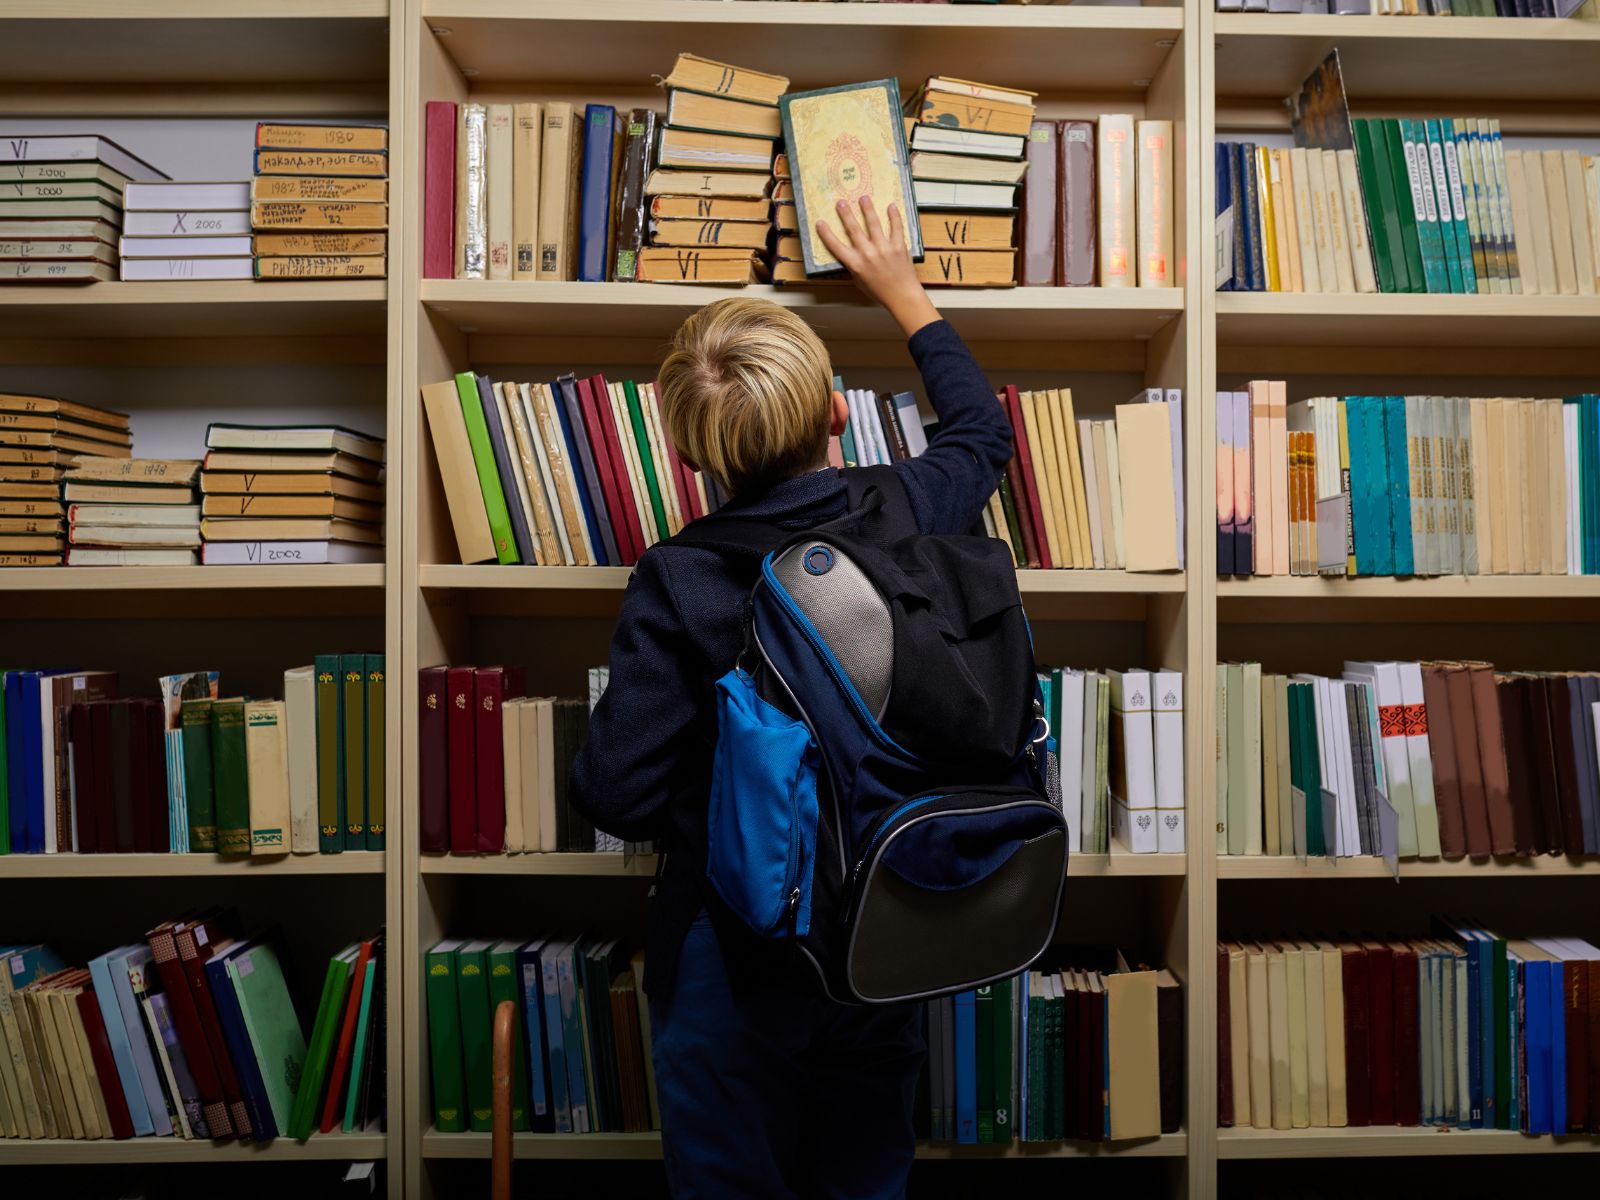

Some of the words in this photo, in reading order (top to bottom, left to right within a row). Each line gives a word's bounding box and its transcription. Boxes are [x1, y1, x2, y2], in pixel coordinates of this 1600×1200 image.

[11, 139, 28, 159] VI
[39, 167, 66, 178] 2000
[35, 187, 63, 196] 2000
[701, 175, 712, 191] I
[172, 212, 188, 233] X
[195, 219, 222, 230] 2006
[944, 219, 967, 245] VI
[677, 250, 699, 280] VI
[939, 252, 963, 281] VI
[244, 473, 256, 492] V
[268, 550, 302, 560] 2002
[996, 1108, 1007, 1125] 8
